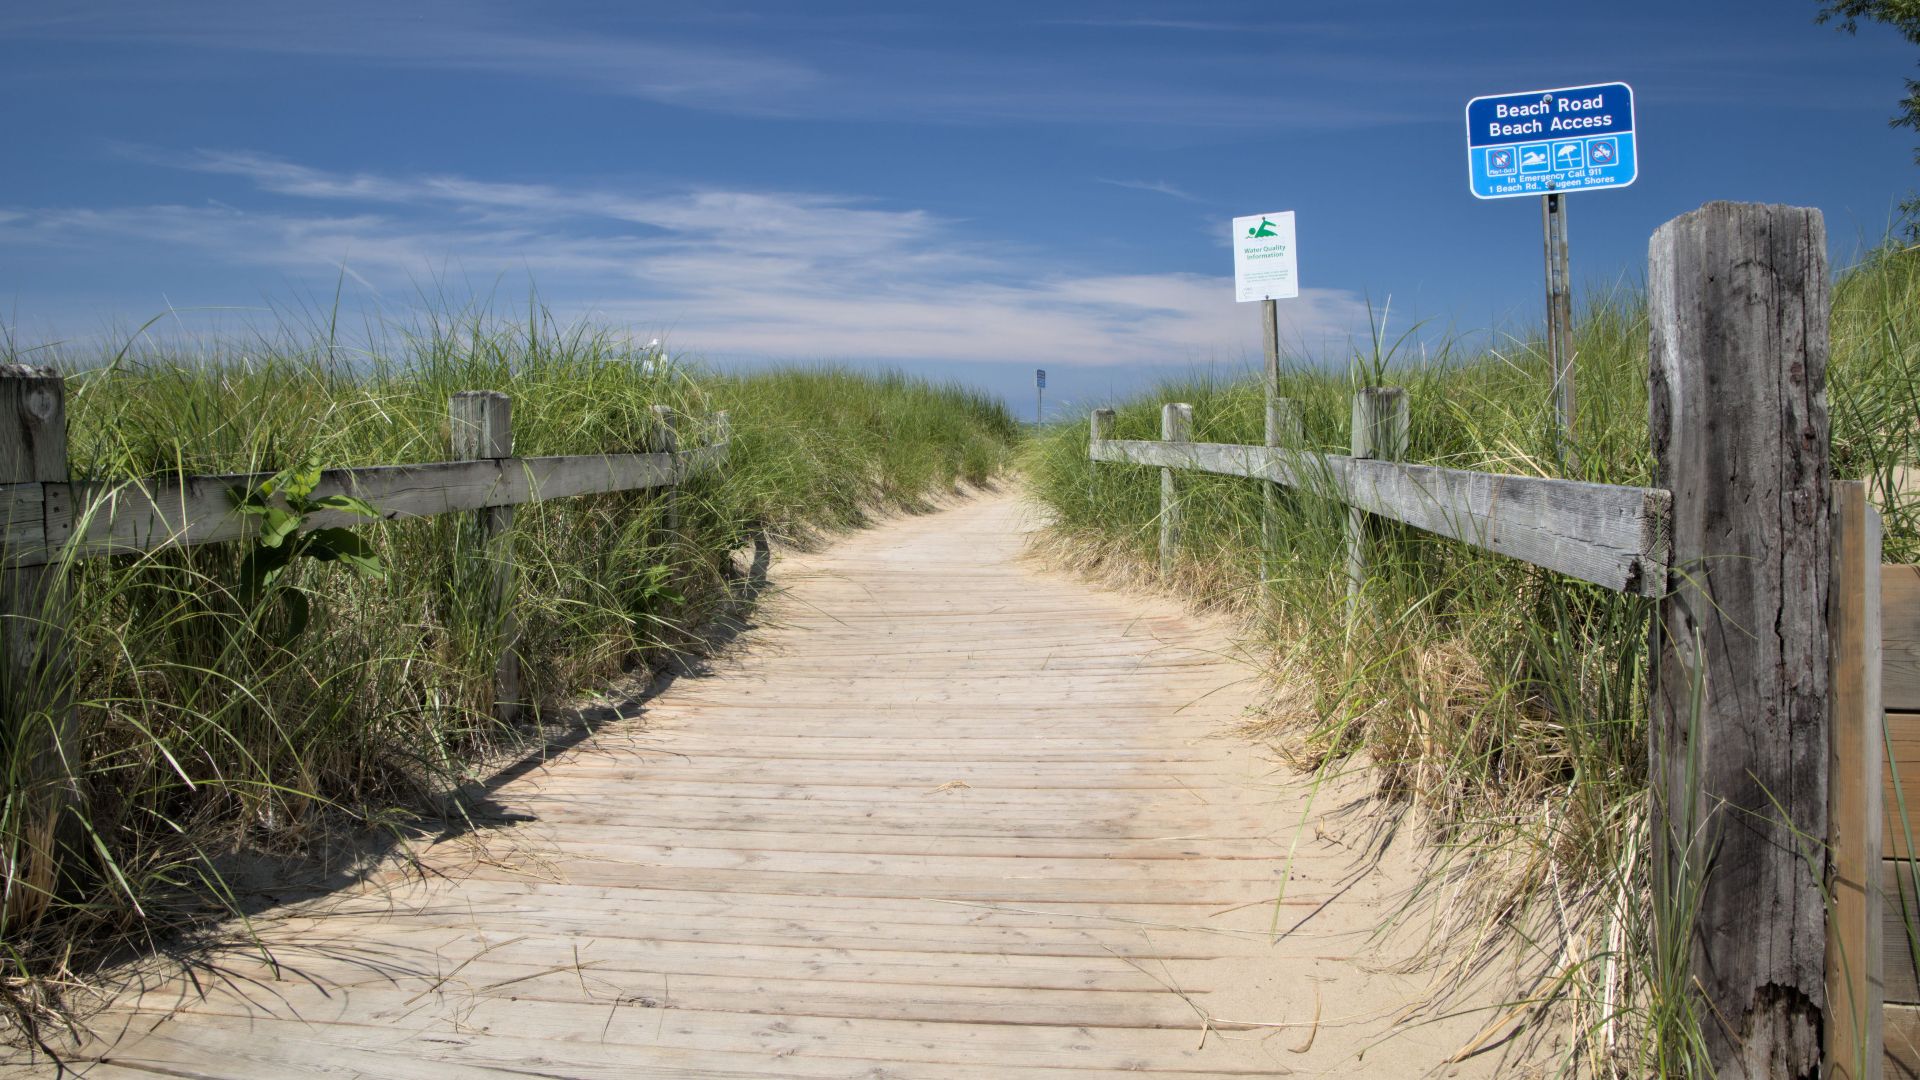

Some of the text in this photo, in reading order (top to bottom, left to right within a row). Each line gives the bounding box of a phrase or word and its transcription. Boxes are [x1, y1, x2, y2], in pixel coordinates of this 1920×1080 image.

[1496, 94, 1603, 119] Beach Road
[1489, 114, 1612, 137] Beach Access
[1489, 185, 1493, 193] 1
[1496, 182, 1522, 193] Beach
[1545, 178, 1581, 189] Sugeen
[1584, 175, 1615, 185] Shores
[1507, 168, 1602, 184] In Emergency Call 911
[1246, 252, 1284, 260] Information
